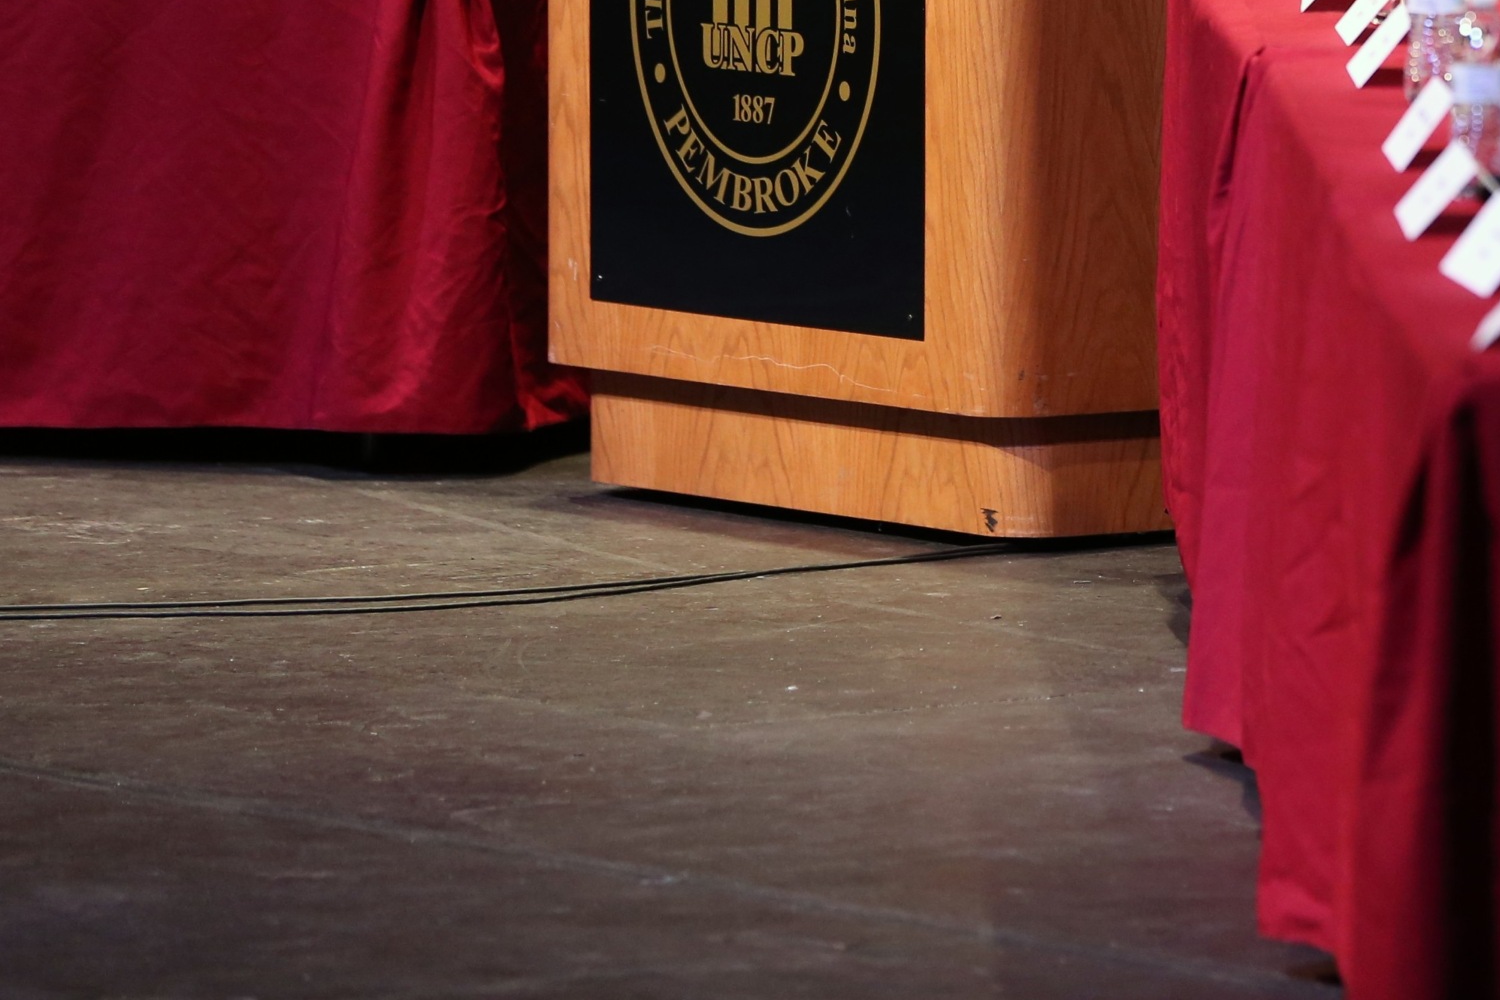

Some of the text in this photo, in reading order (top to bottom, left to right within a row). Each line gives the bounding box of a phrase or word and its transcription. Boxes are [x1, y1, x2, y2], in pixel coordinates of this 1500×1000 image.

[700, 22, 804, 77] UNCP
[732, 94, 775, 125] 1887
[664, 103, 842, 214] PEMBROKE
